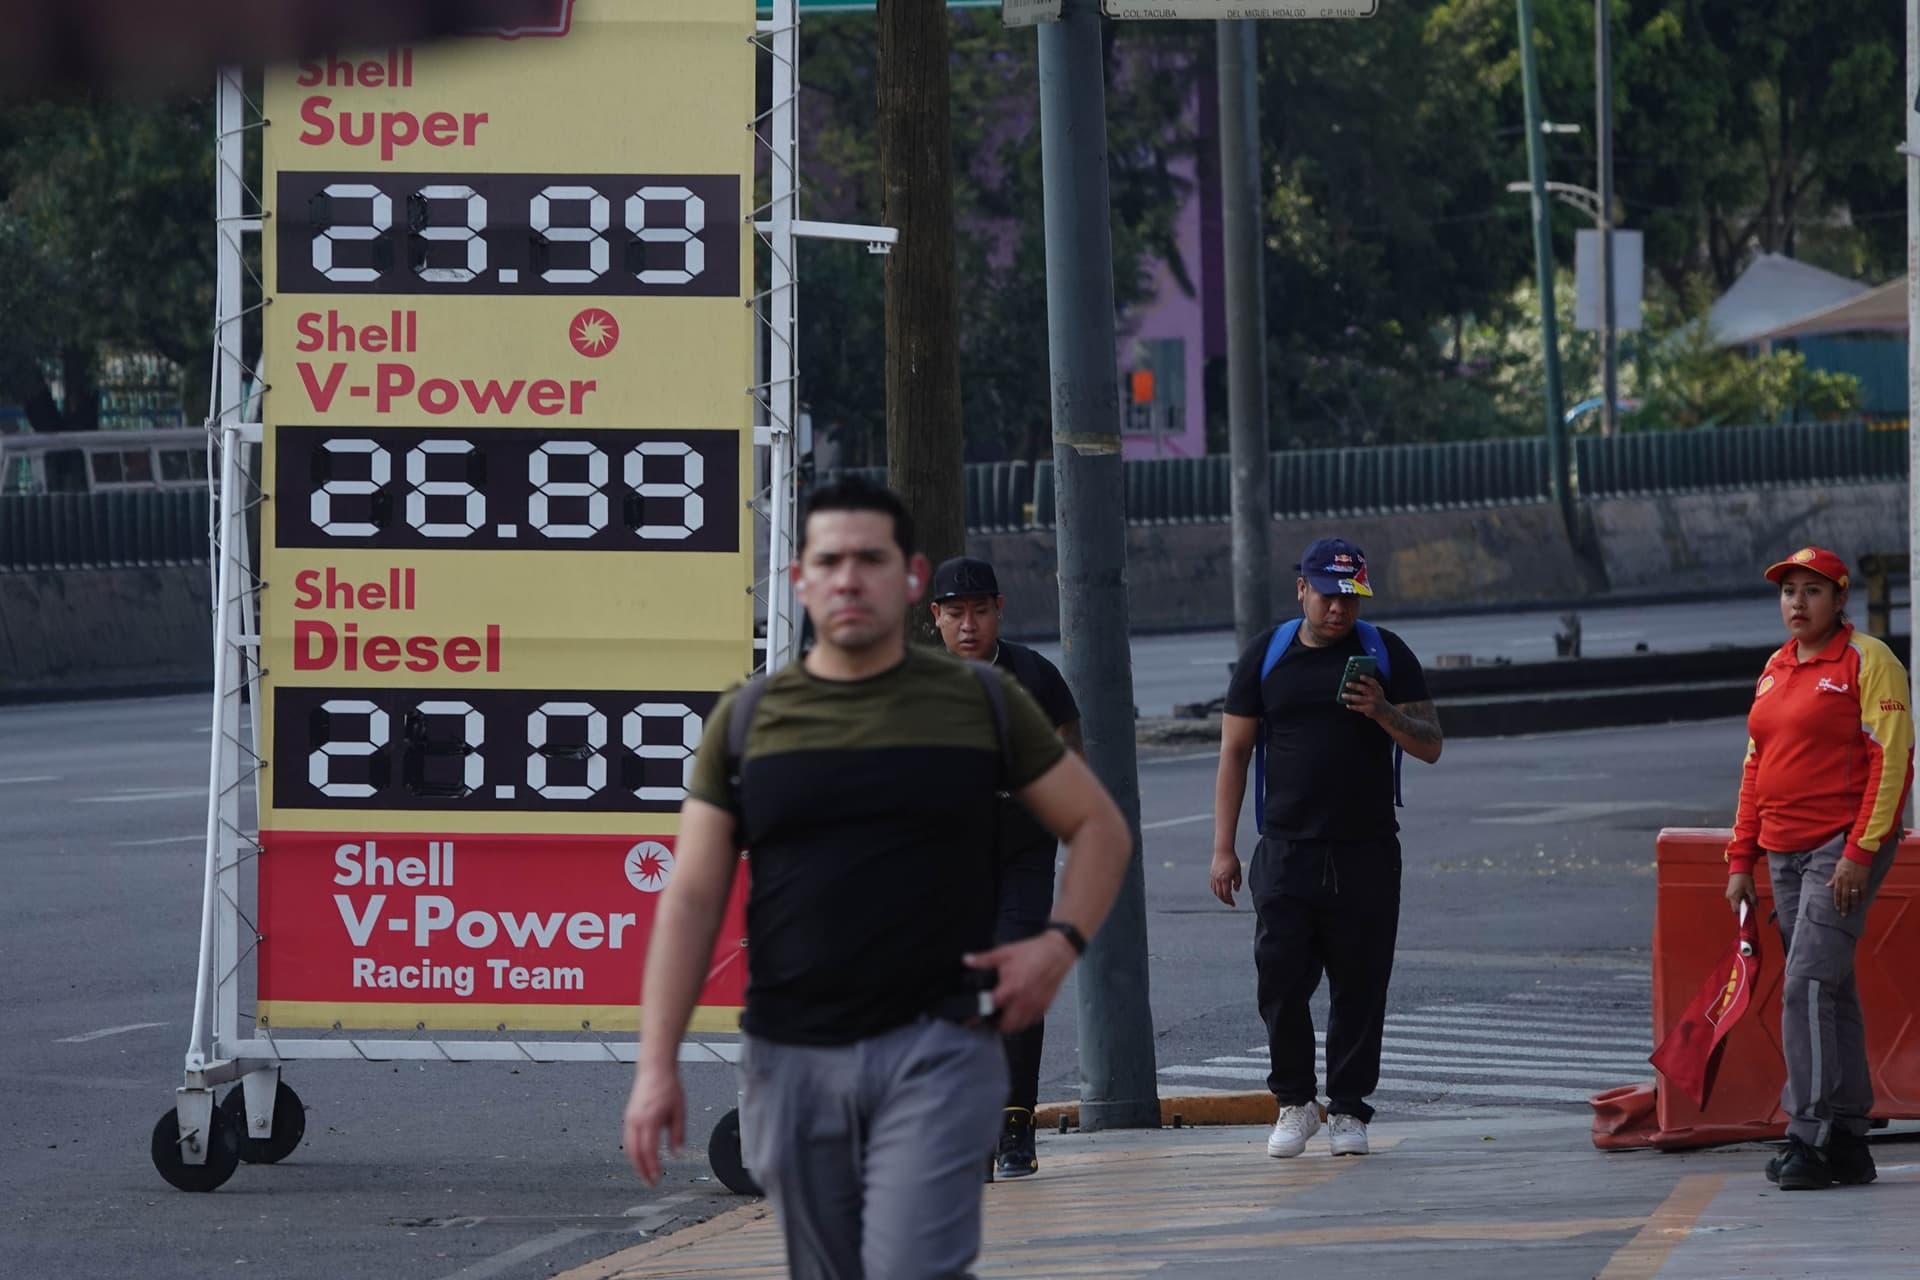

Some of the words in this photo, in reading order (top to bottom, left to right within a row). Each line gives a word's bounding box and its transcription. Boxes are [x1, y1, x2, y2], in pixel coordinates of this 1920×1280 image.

[1245, 9, 1269, 17] MIGUEL
[1272, 9, 1306, 17] HIDALGO
[297, 48, 413, 88] Shell
[299, 95, 489, 161] Super
[312, 184, 705, 284] 23.99
[296, 309, 417, 353] Shell
[296, 362, 597, 416] V-Power
[310, 438, 704, 540] 26.89
[294, 567, 416, 611] Shell
[293, 619, 501, 673] Diesel
[308, 700, 703, 800] 27.09
[334, 841, 454, 887] Shell
[333, 894, 636, 950] V-Power
[352, 957, 475, 997] Racing
[486, 959, 584, 991] Team
